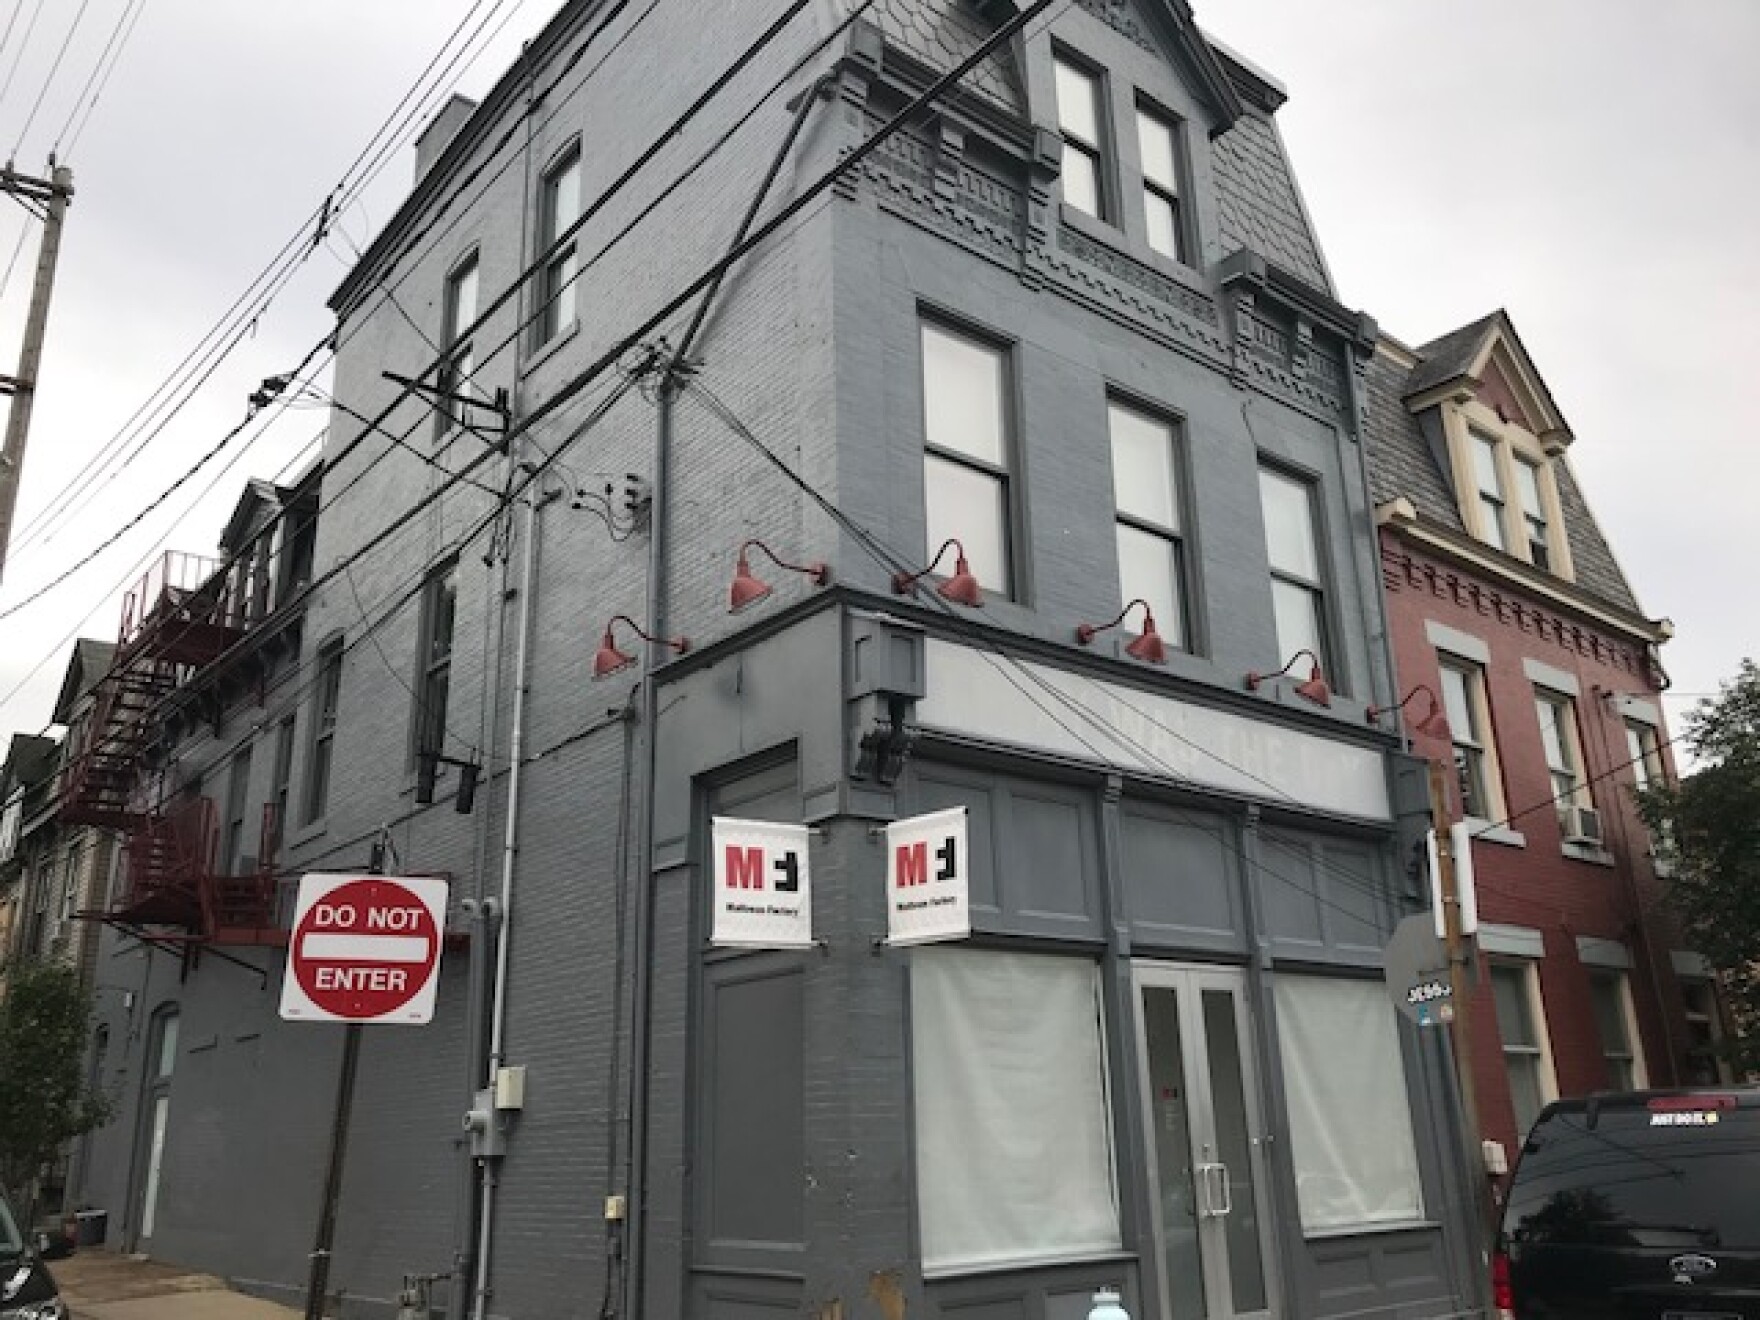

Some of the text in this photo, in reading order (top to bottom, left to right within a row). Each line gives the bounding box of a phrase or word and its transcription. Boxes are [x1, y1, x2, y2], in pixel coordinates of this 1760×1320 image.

[315, 905, 424, 930] DO NOT
[315, 967, 408, 991] ENTER
